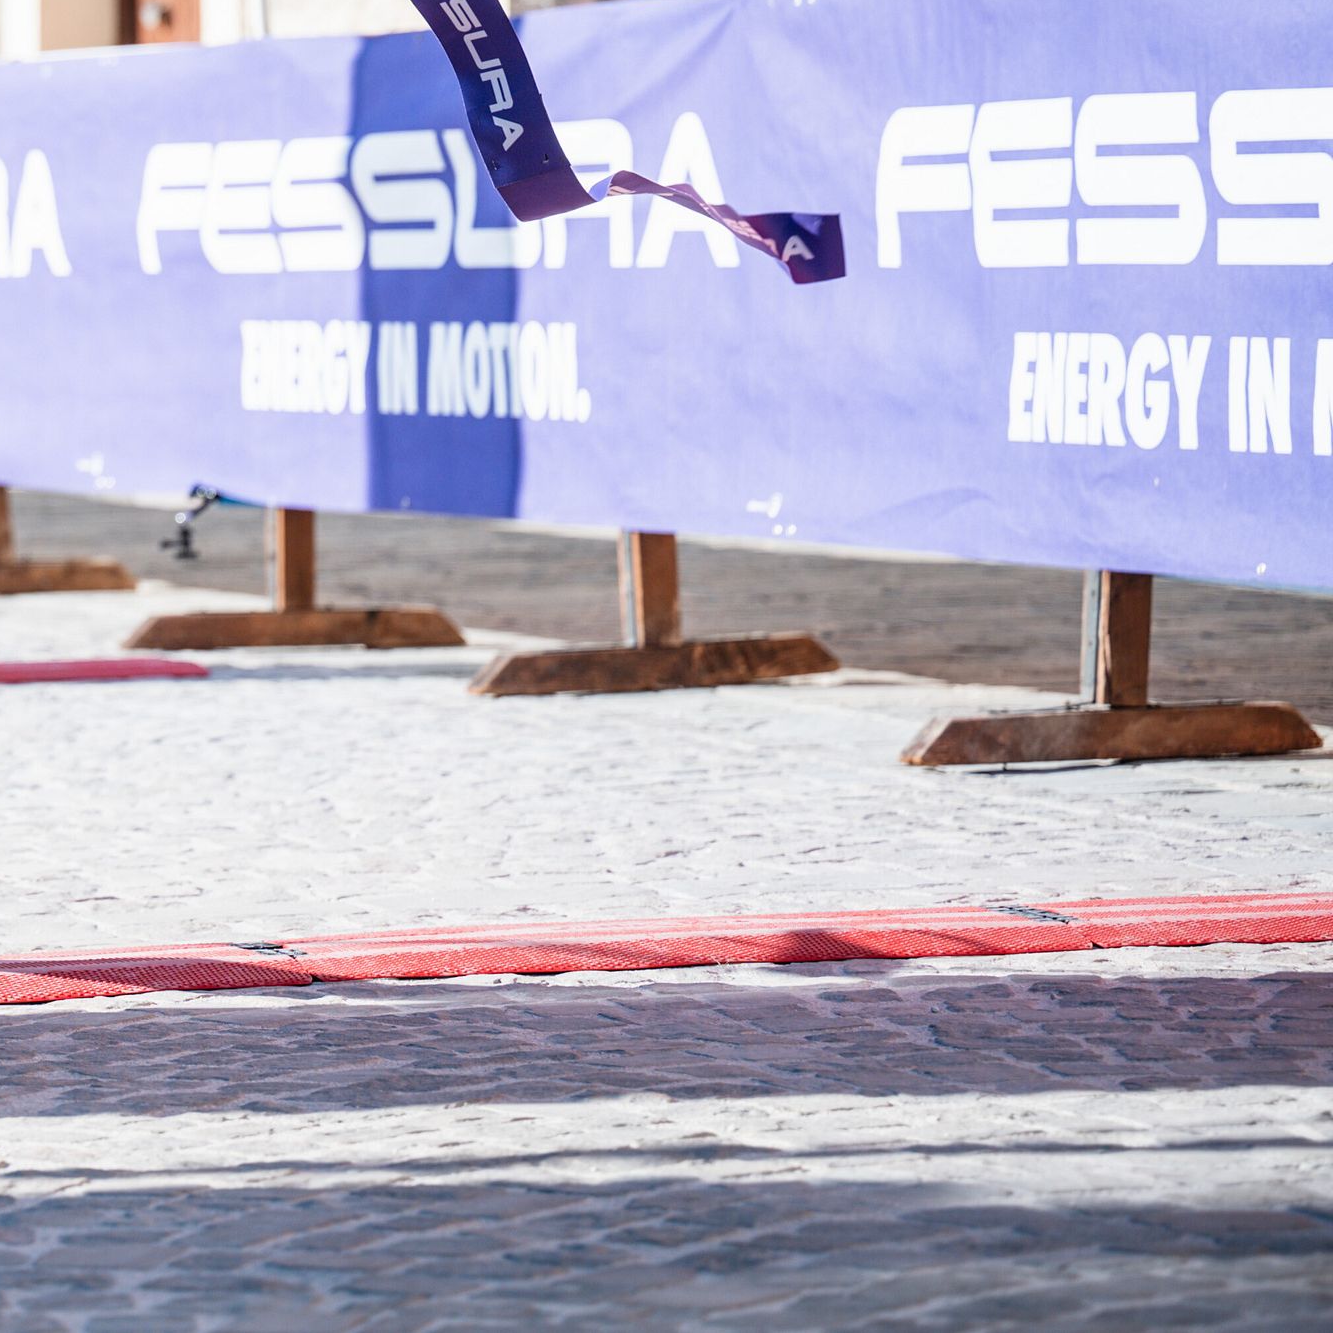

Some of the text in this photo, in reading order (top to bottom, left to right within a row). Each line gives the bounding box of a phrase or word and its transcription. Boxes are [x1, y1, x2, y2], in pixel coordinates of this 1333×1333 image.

[137, 111, 741, 276] FESSURA
[876, 87, 1333, 268] FESS
[377, 320, 420, 416] IN
[1008, 331, 1213, 450] ENERGY
[1228, 336, 1293, 455] IN
